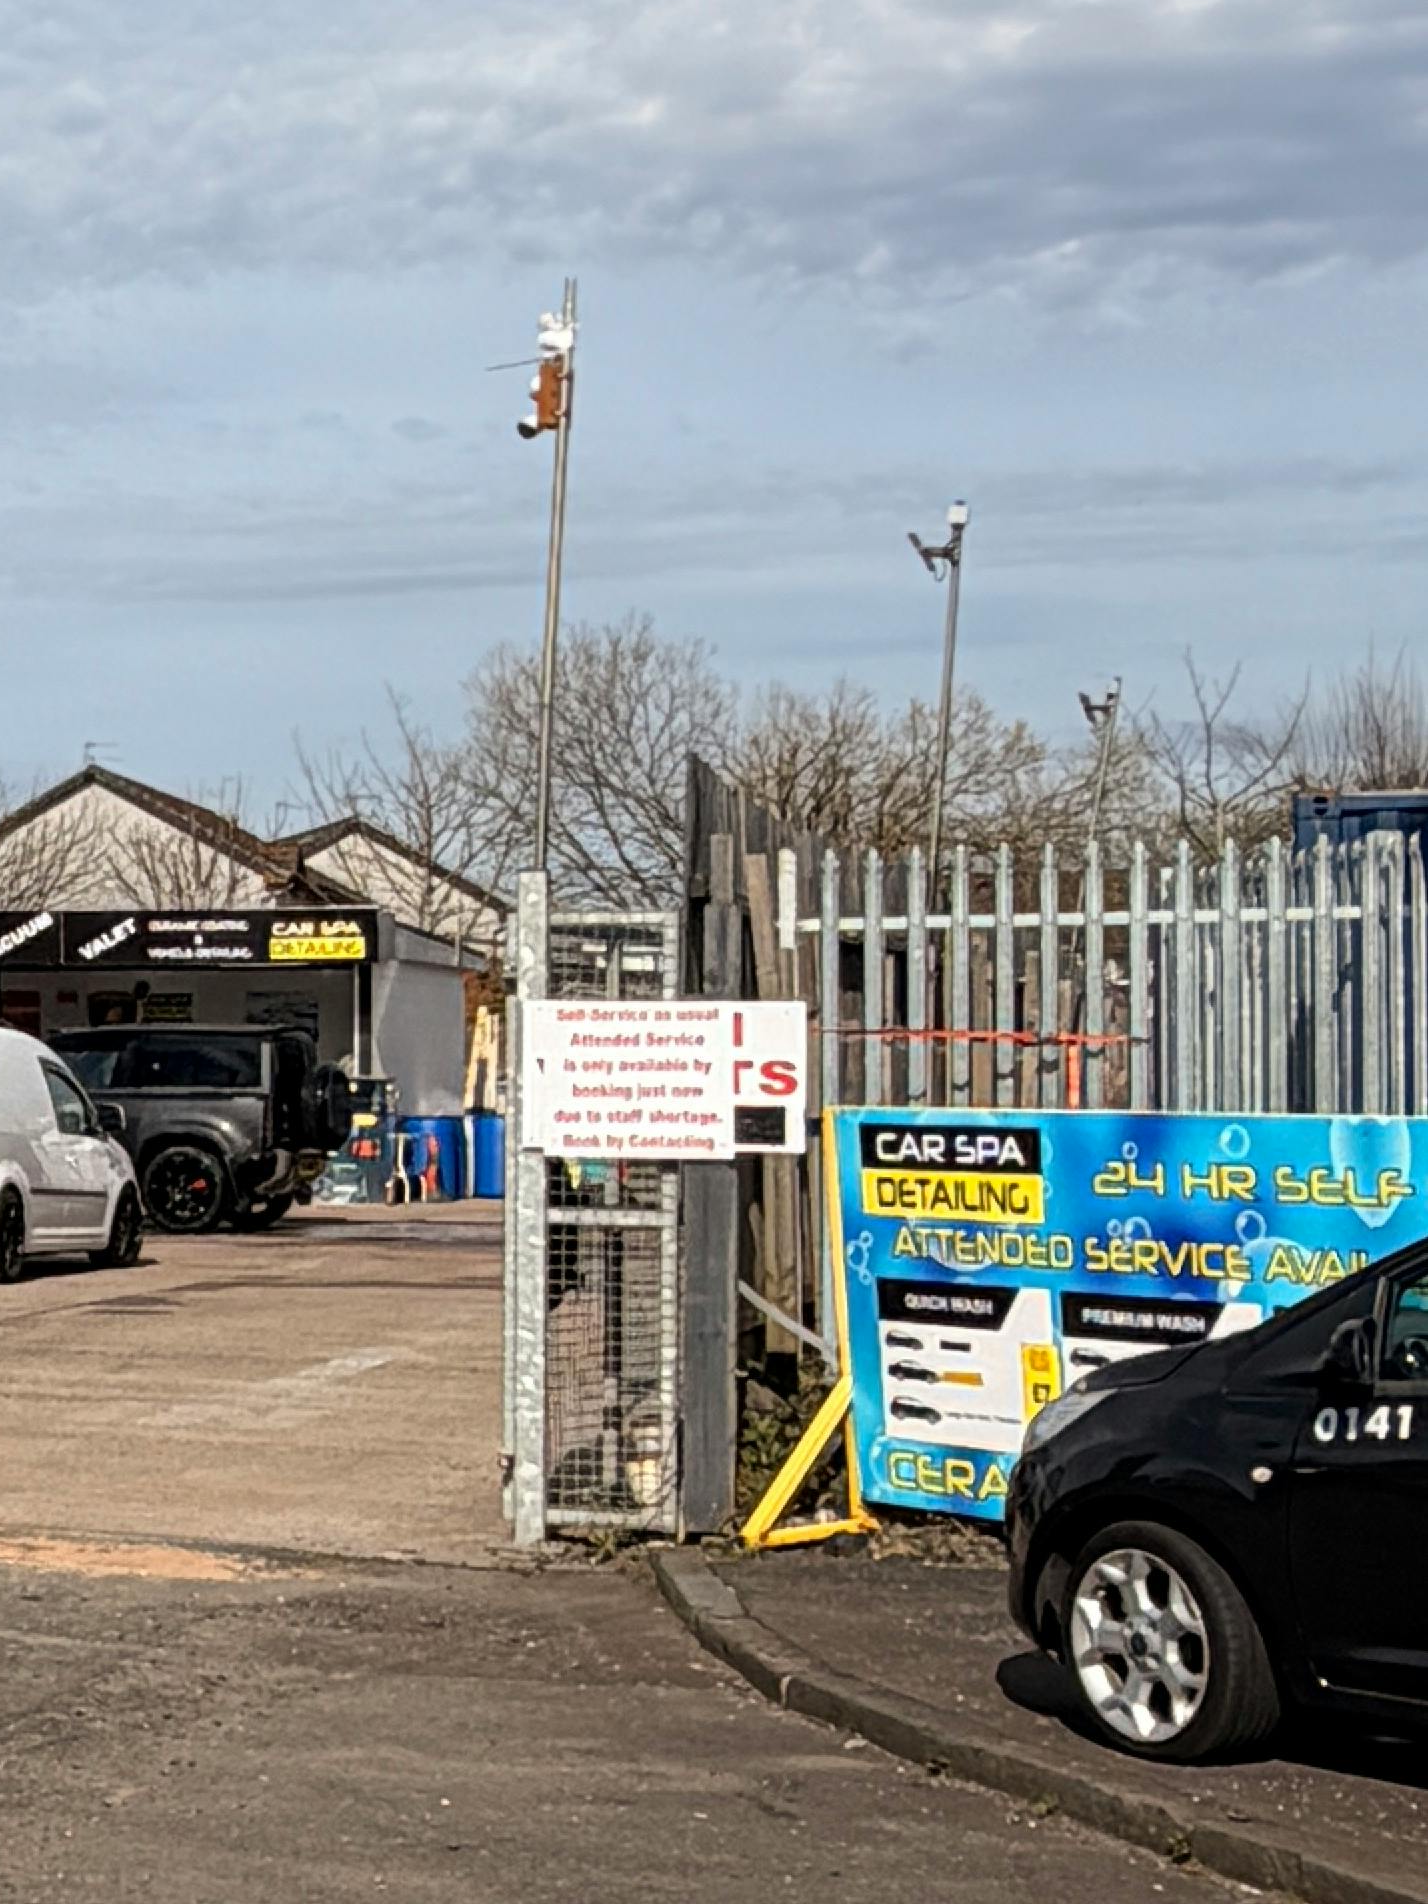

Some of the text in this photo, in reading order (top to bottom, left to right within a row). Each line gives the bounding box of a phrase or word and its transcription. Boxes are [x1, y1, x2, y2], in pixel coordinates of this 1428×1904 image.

[79, 917, 137, 960] VALET
[271, 921, 313, 936] CAR
[676, 1008, 719, 1022] usual
[570, 1032, 705, 1047] Attended Service
[582, 1059, 614, 1076] only
[619, 1058, 688, 1072] available
[693, 1058, 712, 1075] by
[572, 1083, 633, 1101] booking
[637, 1084, 666, 1101] just
[553, 1110, 581, 1123] due
[587, 1110, 601, 1123] to
[607, 1109, 643, 1124] staff
[875, 1132, 1027, 1168] CAR SPA
[1092, 1160, 1416, 1209] 24 HR SELF
[876, 1175, 1030, 1215] DETAILING
[892, 1223, 1074, 1270] ATTENDED
[1084, 1236, 1253, 1281] SERVICE
[1156, 1313, 1206, 1333] WASH
[1313, 1404, 1413, 1442] 0141
